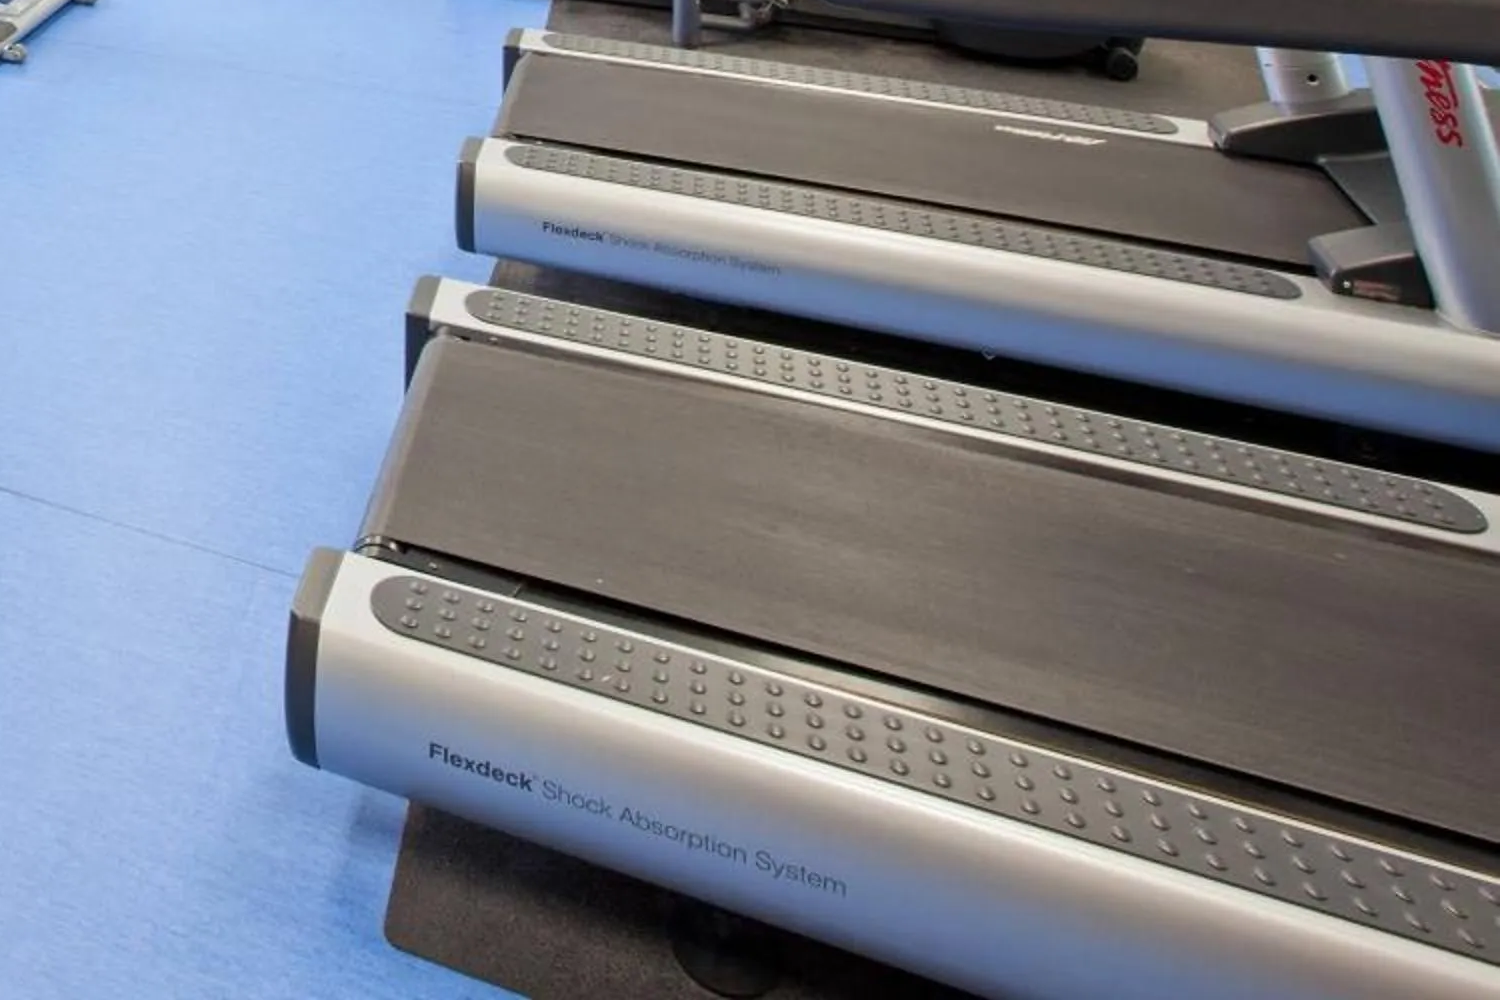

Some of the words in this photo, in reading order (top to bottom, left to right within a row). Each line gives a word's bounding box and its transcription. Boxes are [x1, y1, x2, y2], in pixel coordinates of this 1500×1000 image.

[428, 741, 533, 793] Flexdeck
[541, 779, 613, 819] Shock
[619, 806, 748, 864] Absorption
[754, 849, 848, 899] System
